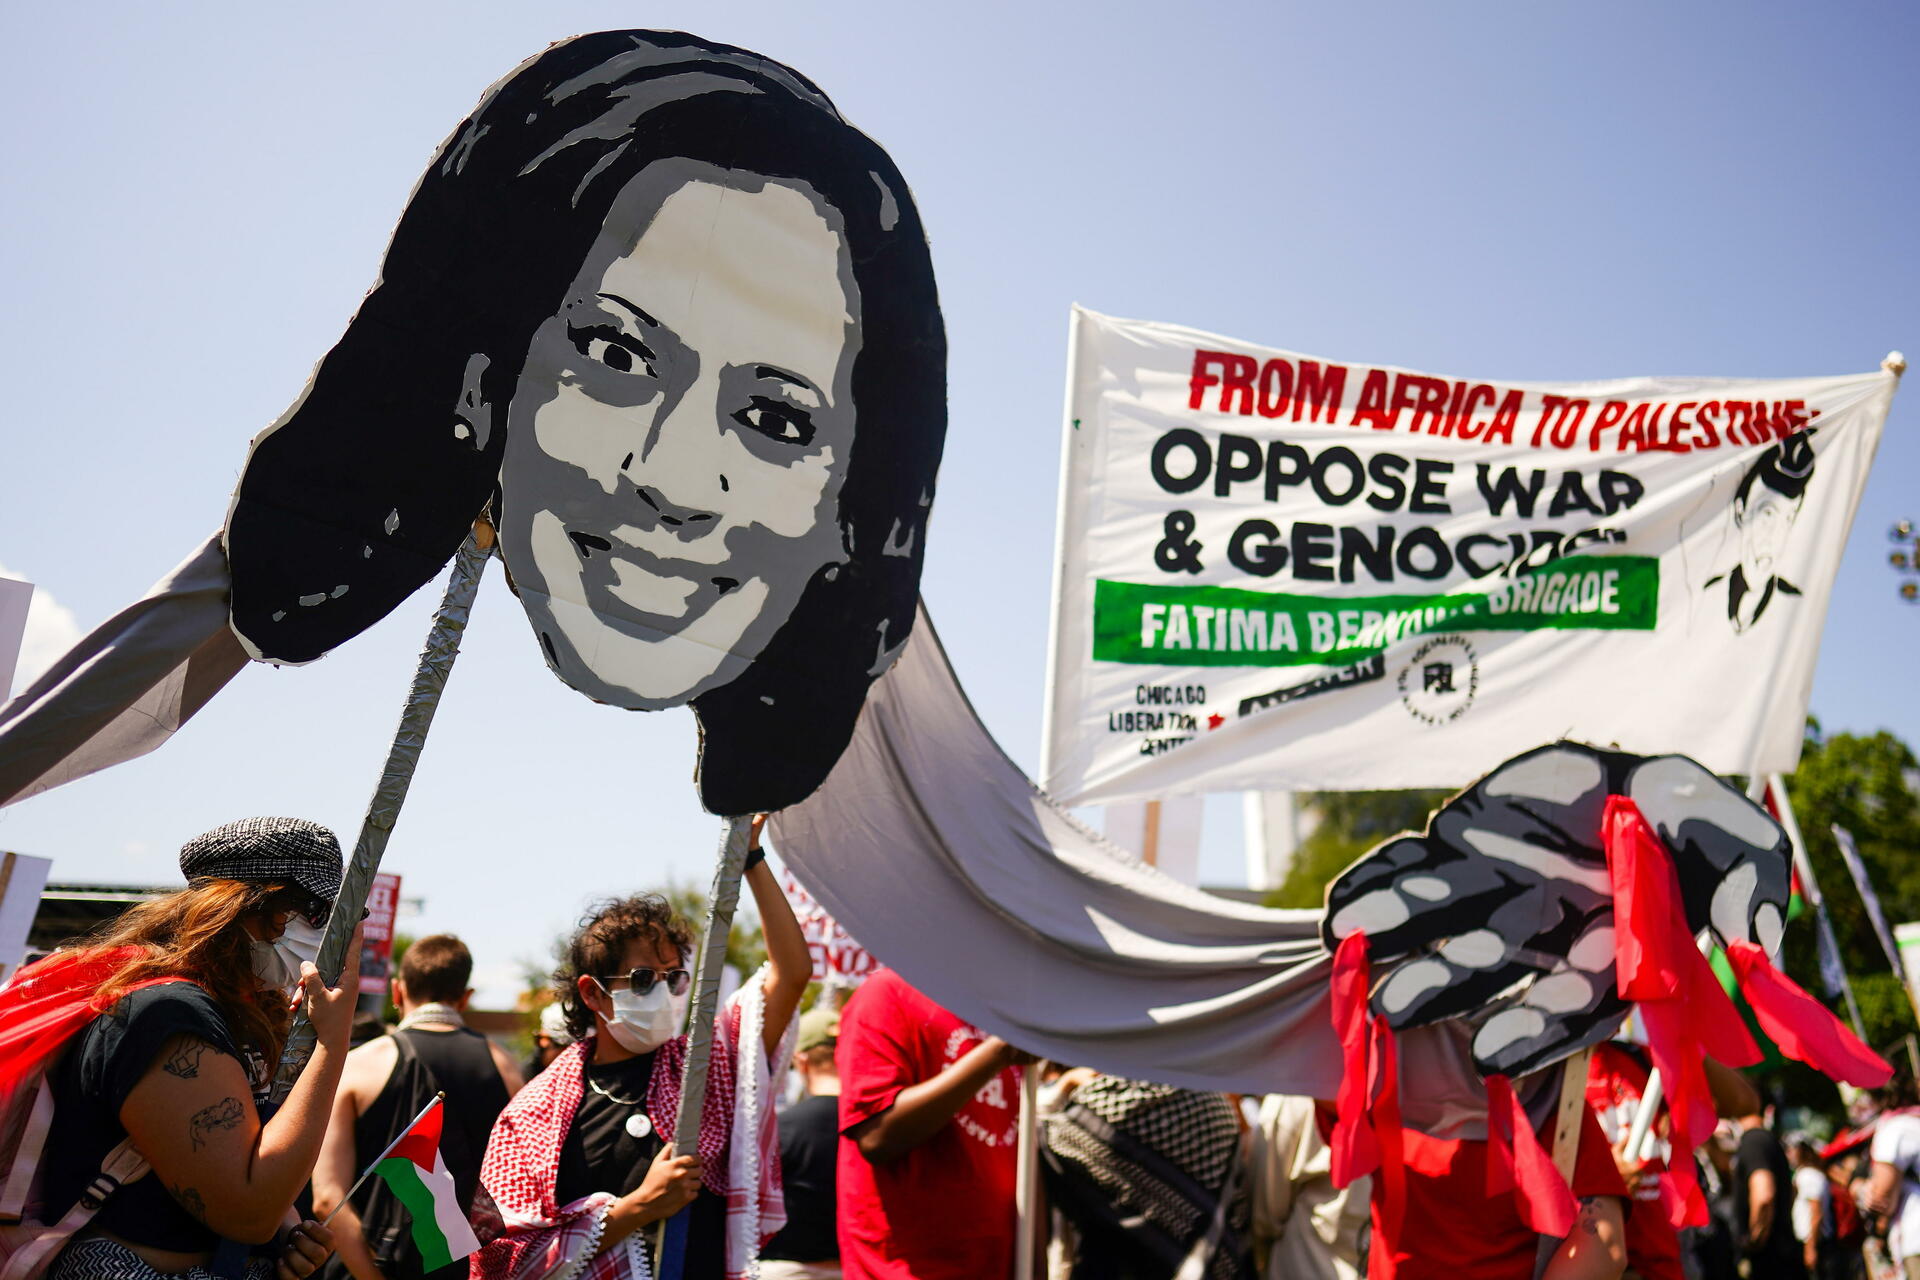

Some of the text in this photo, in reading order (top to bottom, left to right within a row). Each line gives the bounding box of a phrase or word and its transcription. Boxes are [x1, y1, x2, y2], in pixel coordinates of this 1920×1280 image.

[1188, 349, 1347, 424] FROM
[1351, 369, 1524, 444] AFRICA
[1530, 394, 1590, 449] TO
[1151, 428, 1645, 518] OPPOSE WAR
[1154, 510, 1204, 575] &
[1141, 603, 1298, 651] FATIMA
[1136, 685, 1206, 705] CHICAGO
